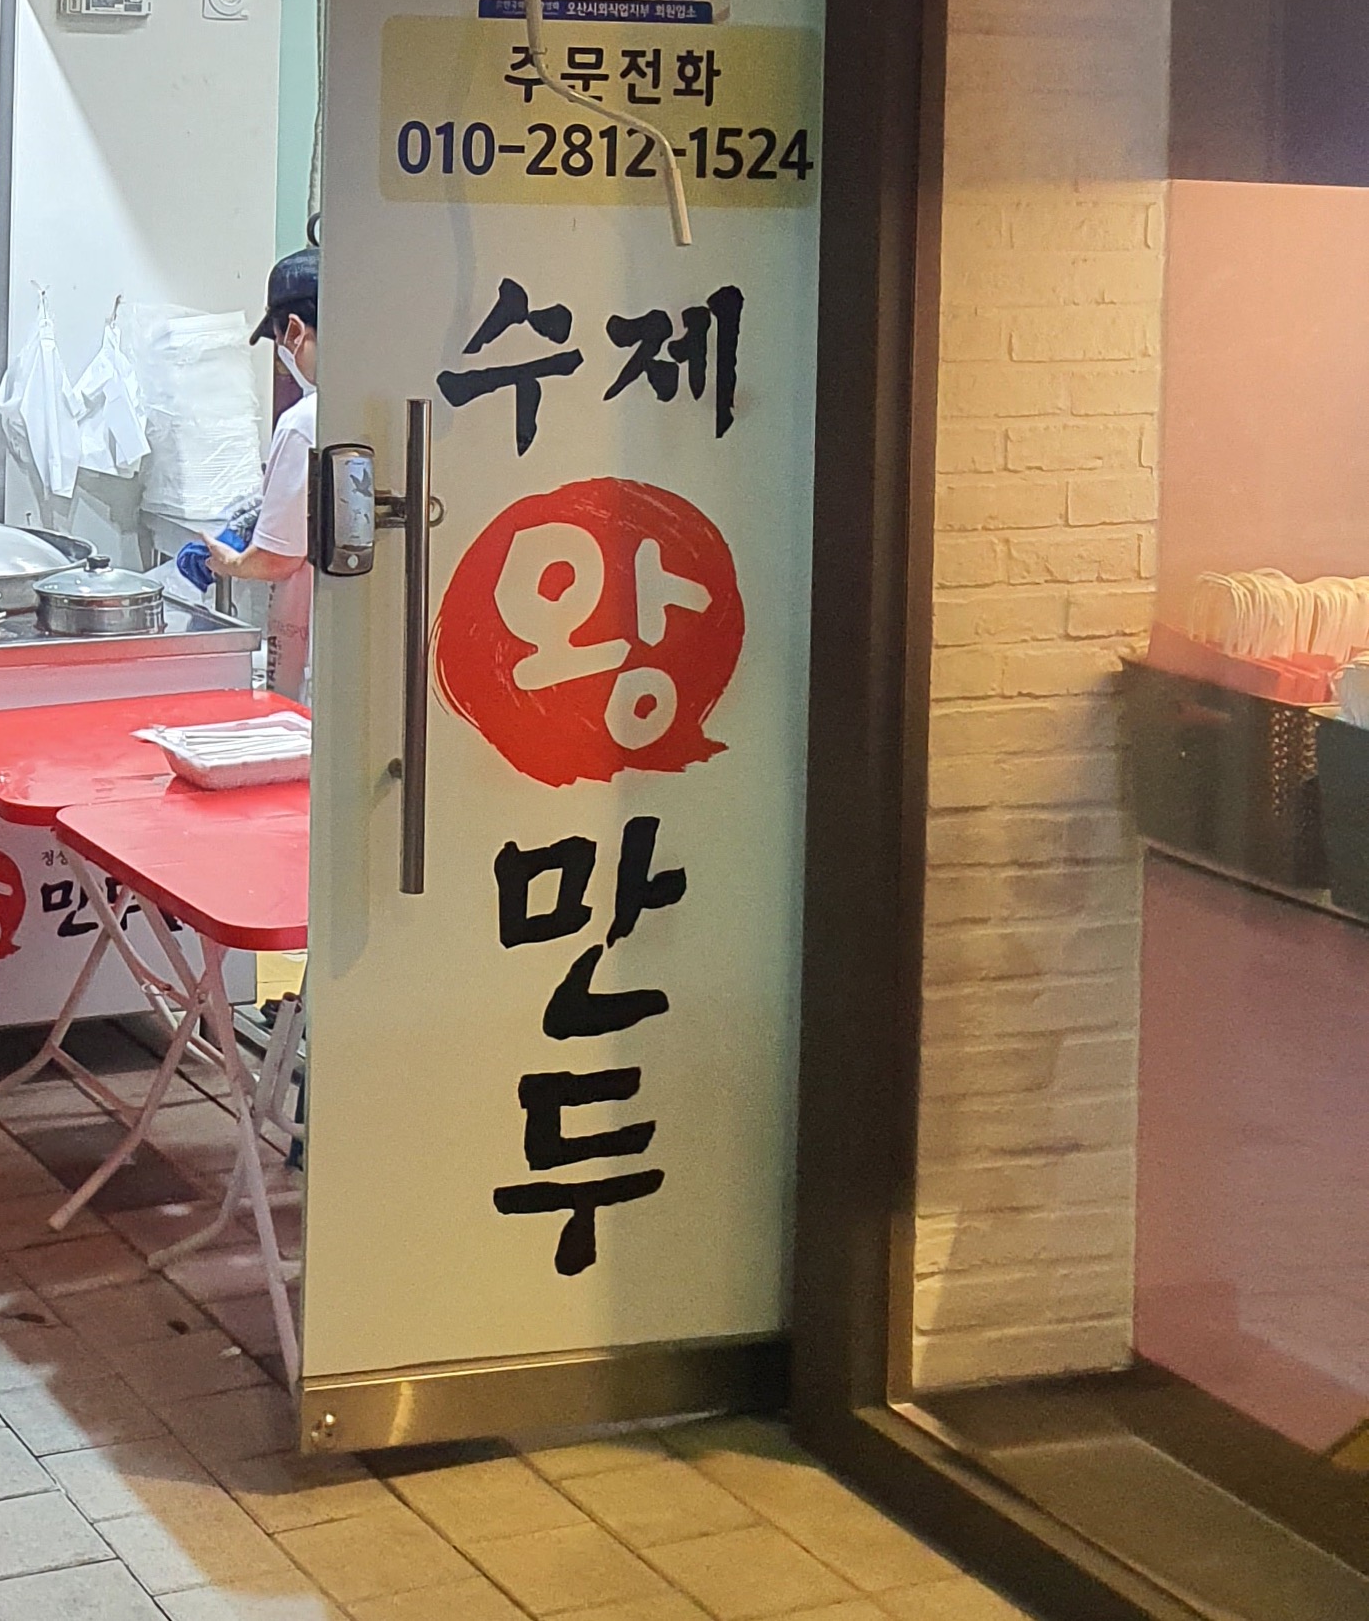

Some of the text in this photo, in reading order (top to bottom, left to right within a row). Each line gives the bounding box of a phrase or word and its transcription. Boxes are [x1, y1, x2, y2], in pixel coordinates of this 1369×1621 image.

[397, 119, 815, 181] 010-2812-1524
[504, 45, 722, 107] 주문전화
[435, 277, 746, 456] 수제
[493, 520, 714, 751] 왕
[491, 815, 689, 1277] 만두
